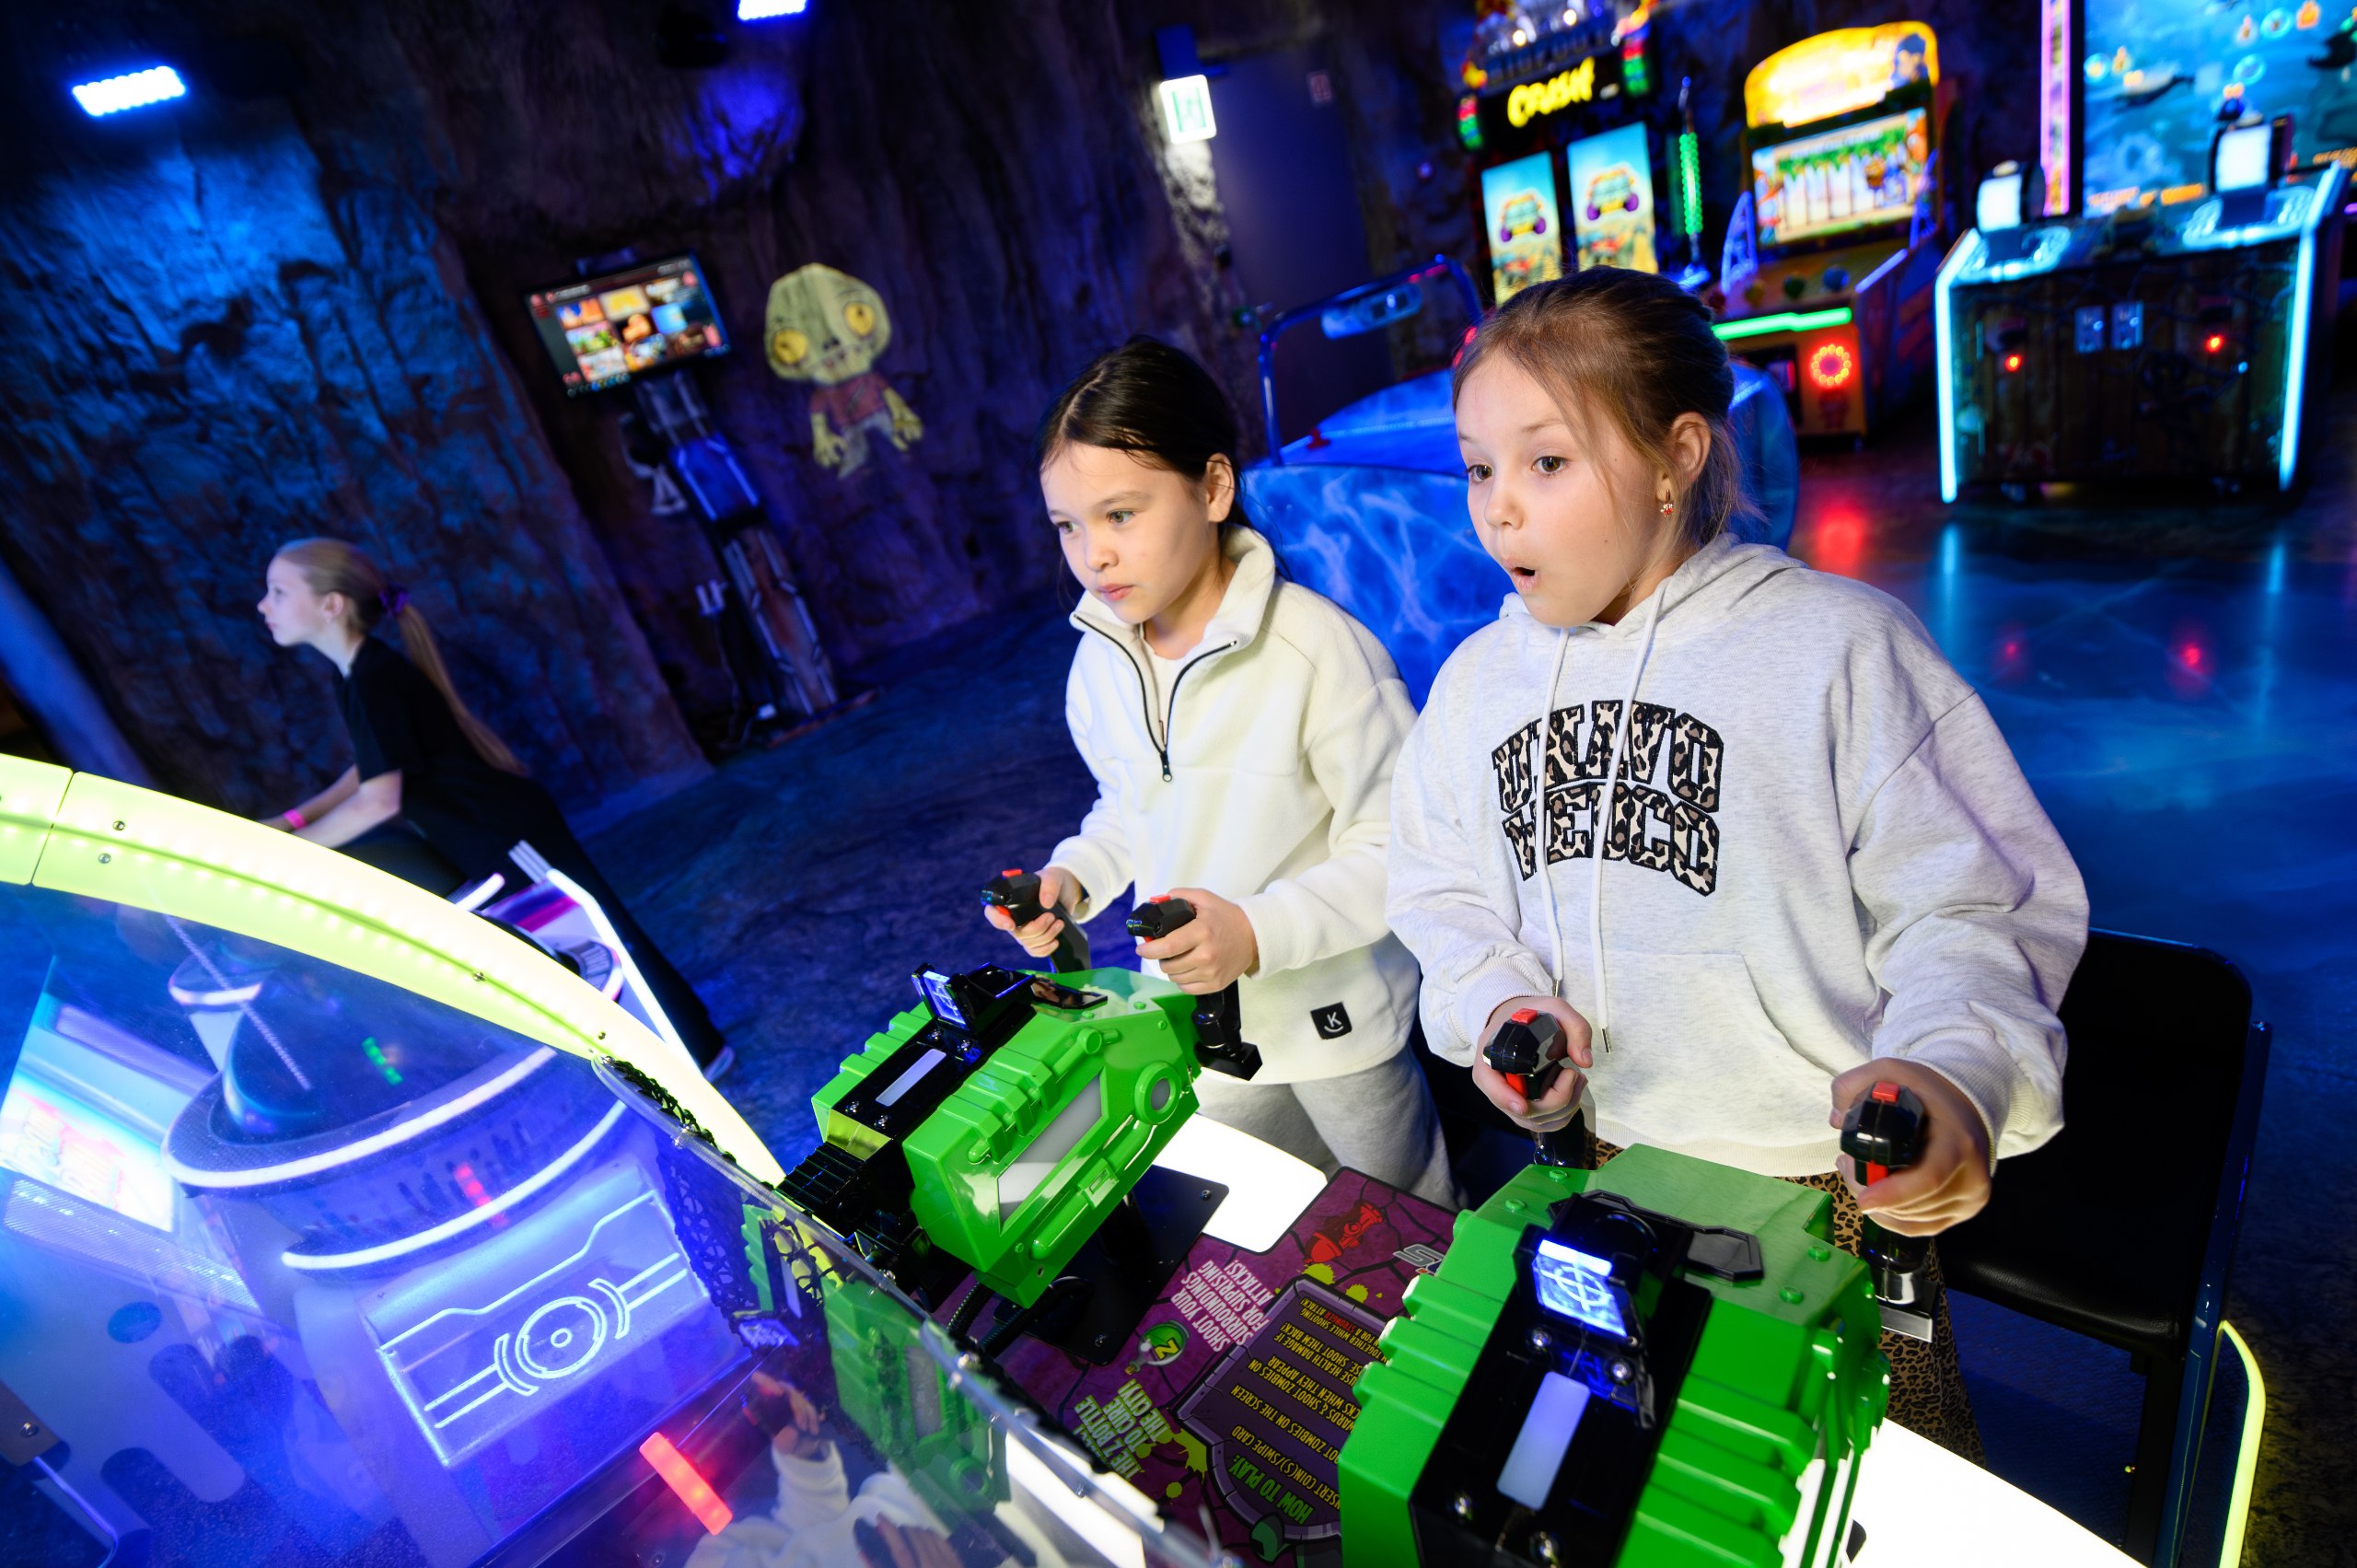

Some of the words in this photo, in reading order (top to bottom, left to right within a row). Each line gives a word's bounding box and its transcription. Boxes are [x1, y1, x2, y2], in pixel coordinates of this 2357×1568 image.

[1327, 1011, 1342, 1028] K
[1197, 1259, 1251, 1313] SUPRISING
[1223, 1257, 1274, 1306] ATTACKS!
[1169, 1287, 1203, 1320] YOUR
[1179, 1269, 1254, 1346] SURROUNDINGS
[1299, 1296, 1327, 1315] ATTACK!
[1240, 1305, 1270, 1332] FOR
[1299, 1307, 1330, 1329] SHOOTING
[1324, 1309, 1356, 1332] STRONGER
[1191, 1312, 1231, 1352] SHOOT
[1279, 1321, 1305, 1341] BACK!
[1301, 1333, 1324, 1352] THEM
[1328, 1323, 1351, 1340] WHILE
[1358, 1330, 1375, 1343] FOR
[1152, 1338, 1179, 1359] Z
[1281, 1335, 1315, 1360] DAMAGE
[1320, 1345, 1349, 1367] SHOOT
[1348, 1335, 1382, 1359] TOGETHER
[1247, 1358, 1262, 1373] ON
[1266, 1355, 1300, 1381] APPEAR
[1311, 1353, 1342, 1377] HEALTH
[1258, 1365, 1295, 1394] ZOMBIES
[1295, 1373, 1320, 1393] THEY
[1339, 1370, 1357, 1387] USE
[1116, 1376, 1154, 1418] CITY!
[1229, 1383, 1262, 1411] SCREEN
[1291, 1386, 1322, 1411] SHOOT
[1317, 1387, 1344, 1410] WHEN
[1073, 1393, 1117, 1447] BOTTLE
[1101, 1395, 1137, 1435] CURE
[1258, 1402, 1279, 1421] THE
[1273, 1412, 1292, 1429] ON
[1324, 1407, 1354, 1433] WARDS
[1341, 1401, 1361, 1419] CKS
[1138, 1406, 1170, 1441] THE
[1229, 1423, 1256, 1446] CARD
[1100, 1436, 1124, 1459] Z
[1121, 1424, 1148, 1452] TO
[1286, 1421, 1327, 1453] ZOMBIES
[1108, 1447, 1142, 1481] THE
[1225, 1453, 1266, 1489] PLAY:
[1257, 1476, 1283, 1503] TO
[1313, 1481, 1340, 1508] NSERT
[1275, 1490, 1315, 1524] HOW
